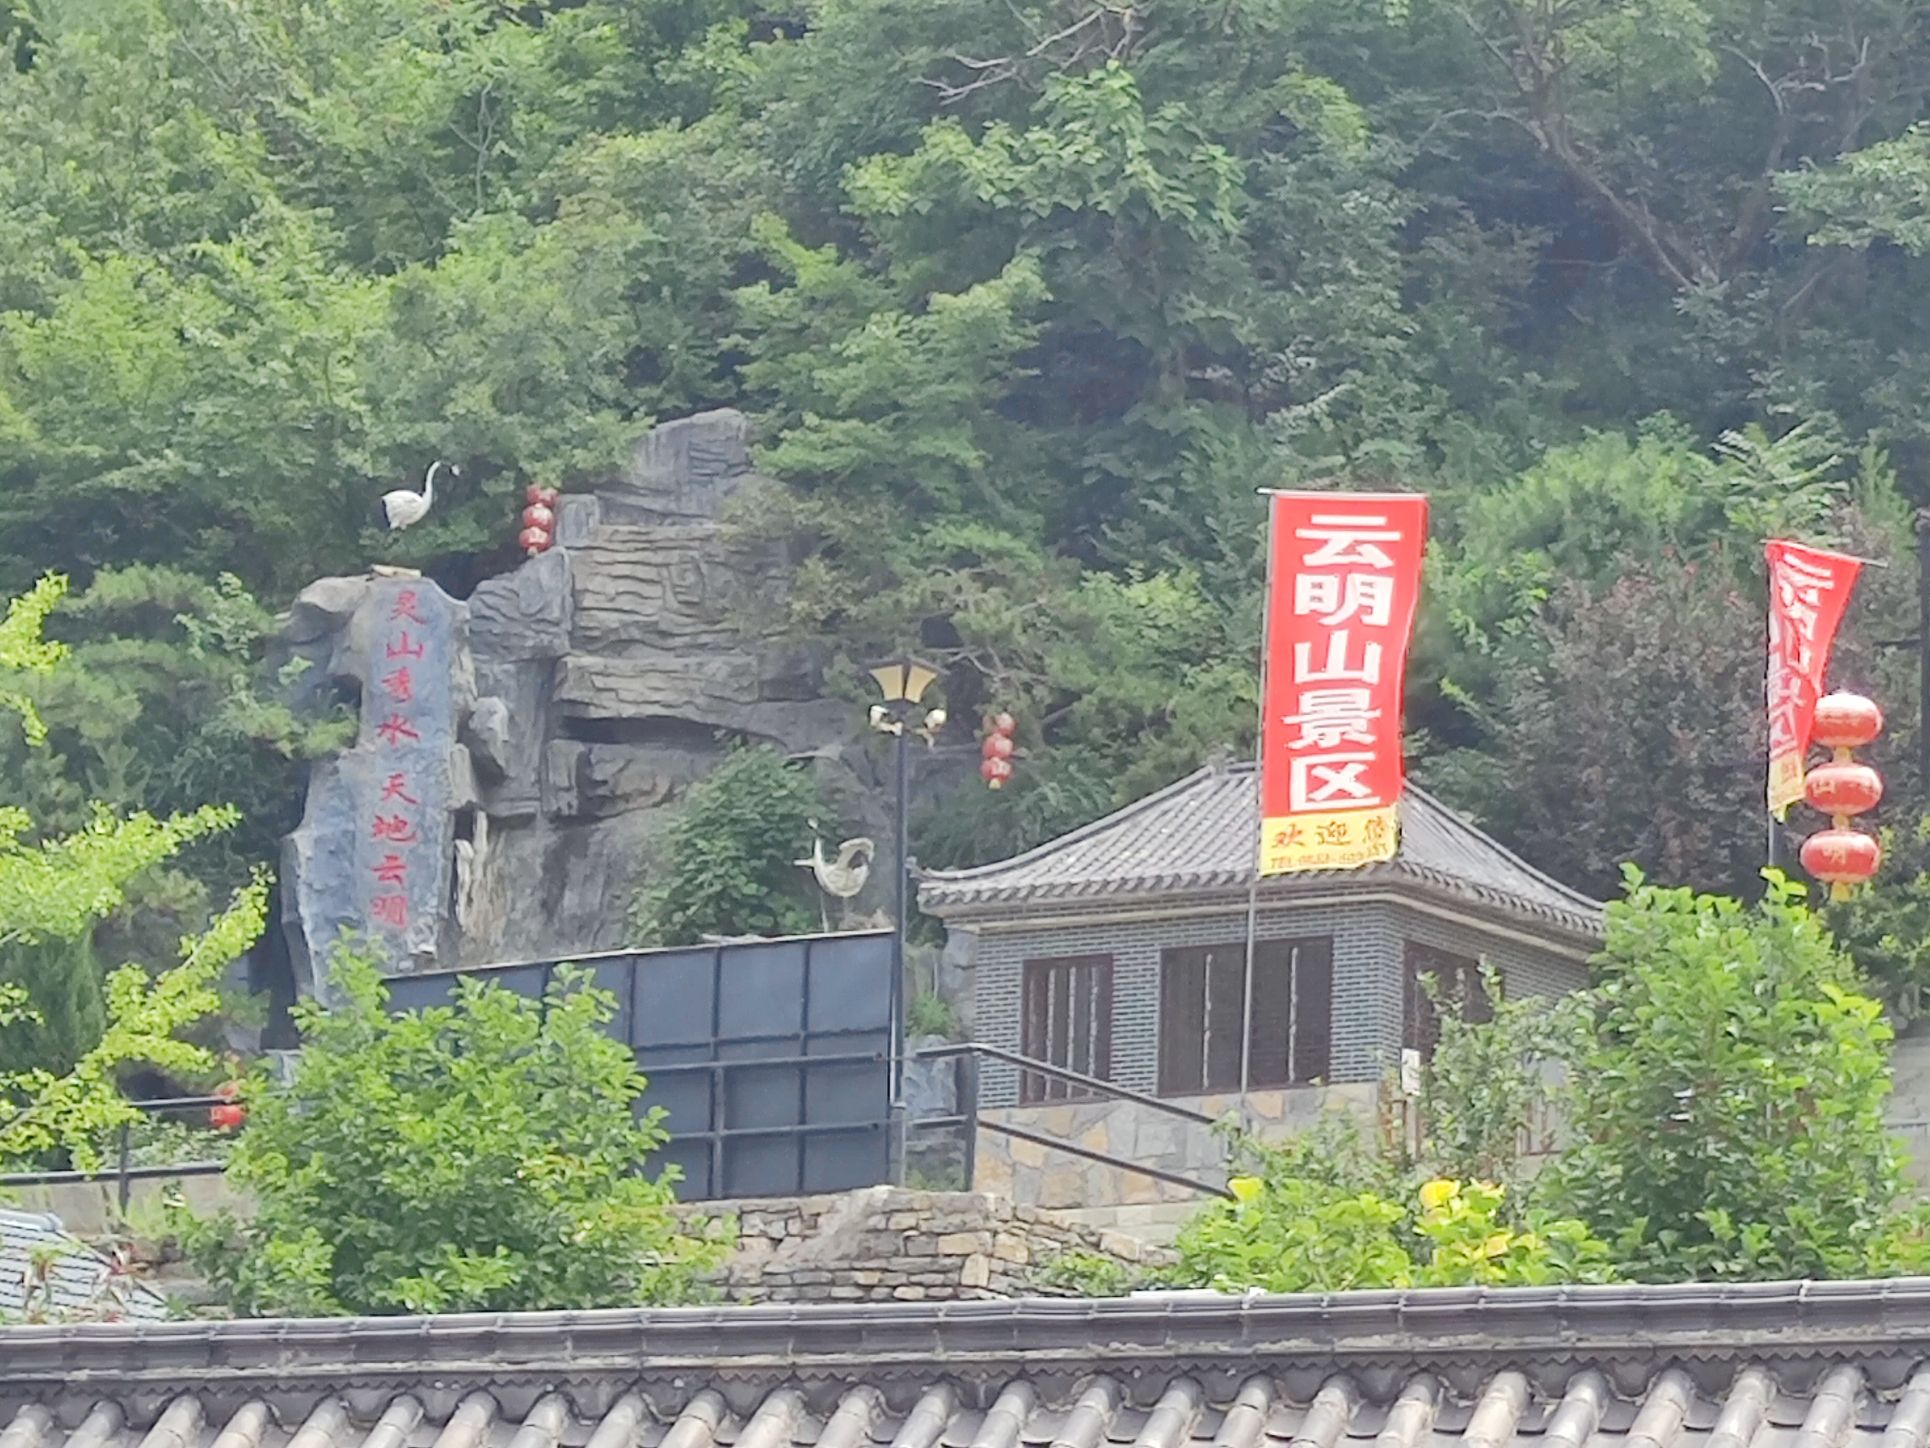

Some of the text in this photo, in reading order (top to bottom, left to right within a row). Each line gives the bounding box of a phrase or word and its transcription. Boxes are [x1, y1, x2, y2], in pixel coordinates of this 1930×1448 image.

[1282, 514, 1402, 812] 云明山景区
